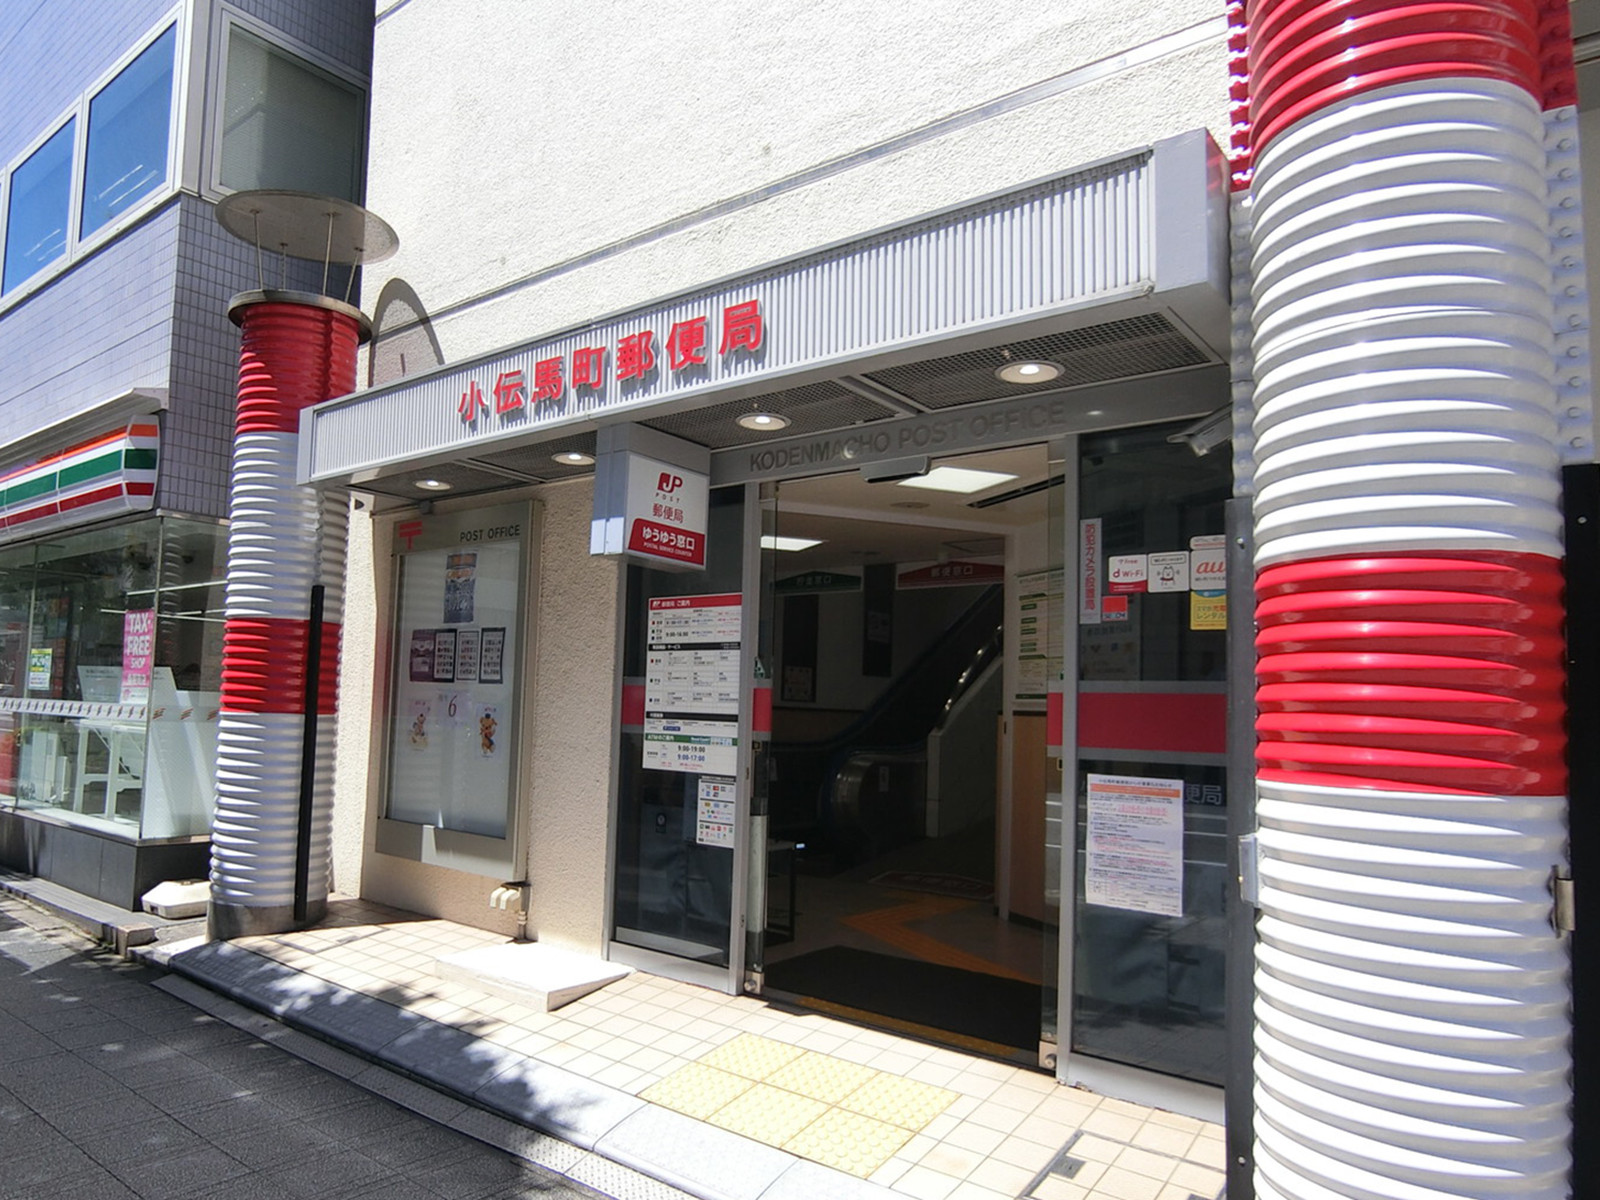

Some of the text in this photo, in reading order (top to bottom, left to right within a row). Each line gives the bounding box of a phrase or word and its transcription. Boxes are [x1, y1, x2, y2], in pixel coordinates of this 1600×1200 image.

[457, 298, 764, 422] 小伝馬町郵便局
[749, 400, 1067, 472] KODENMACHO POST OFFICE
[655, 492, 680, 503] POST
[653, 502, 684, 524] 郵便局
[460, 524, 520, 542] POST OFFICE
[642, 526, 695, 551] ゆうゆう窓口
[1195, 560, 1225, 575] au
[126, 635, 150, 656] FREE
[130, 658, 146, 669] SHOP
[447, 694, 458, 718] 6
